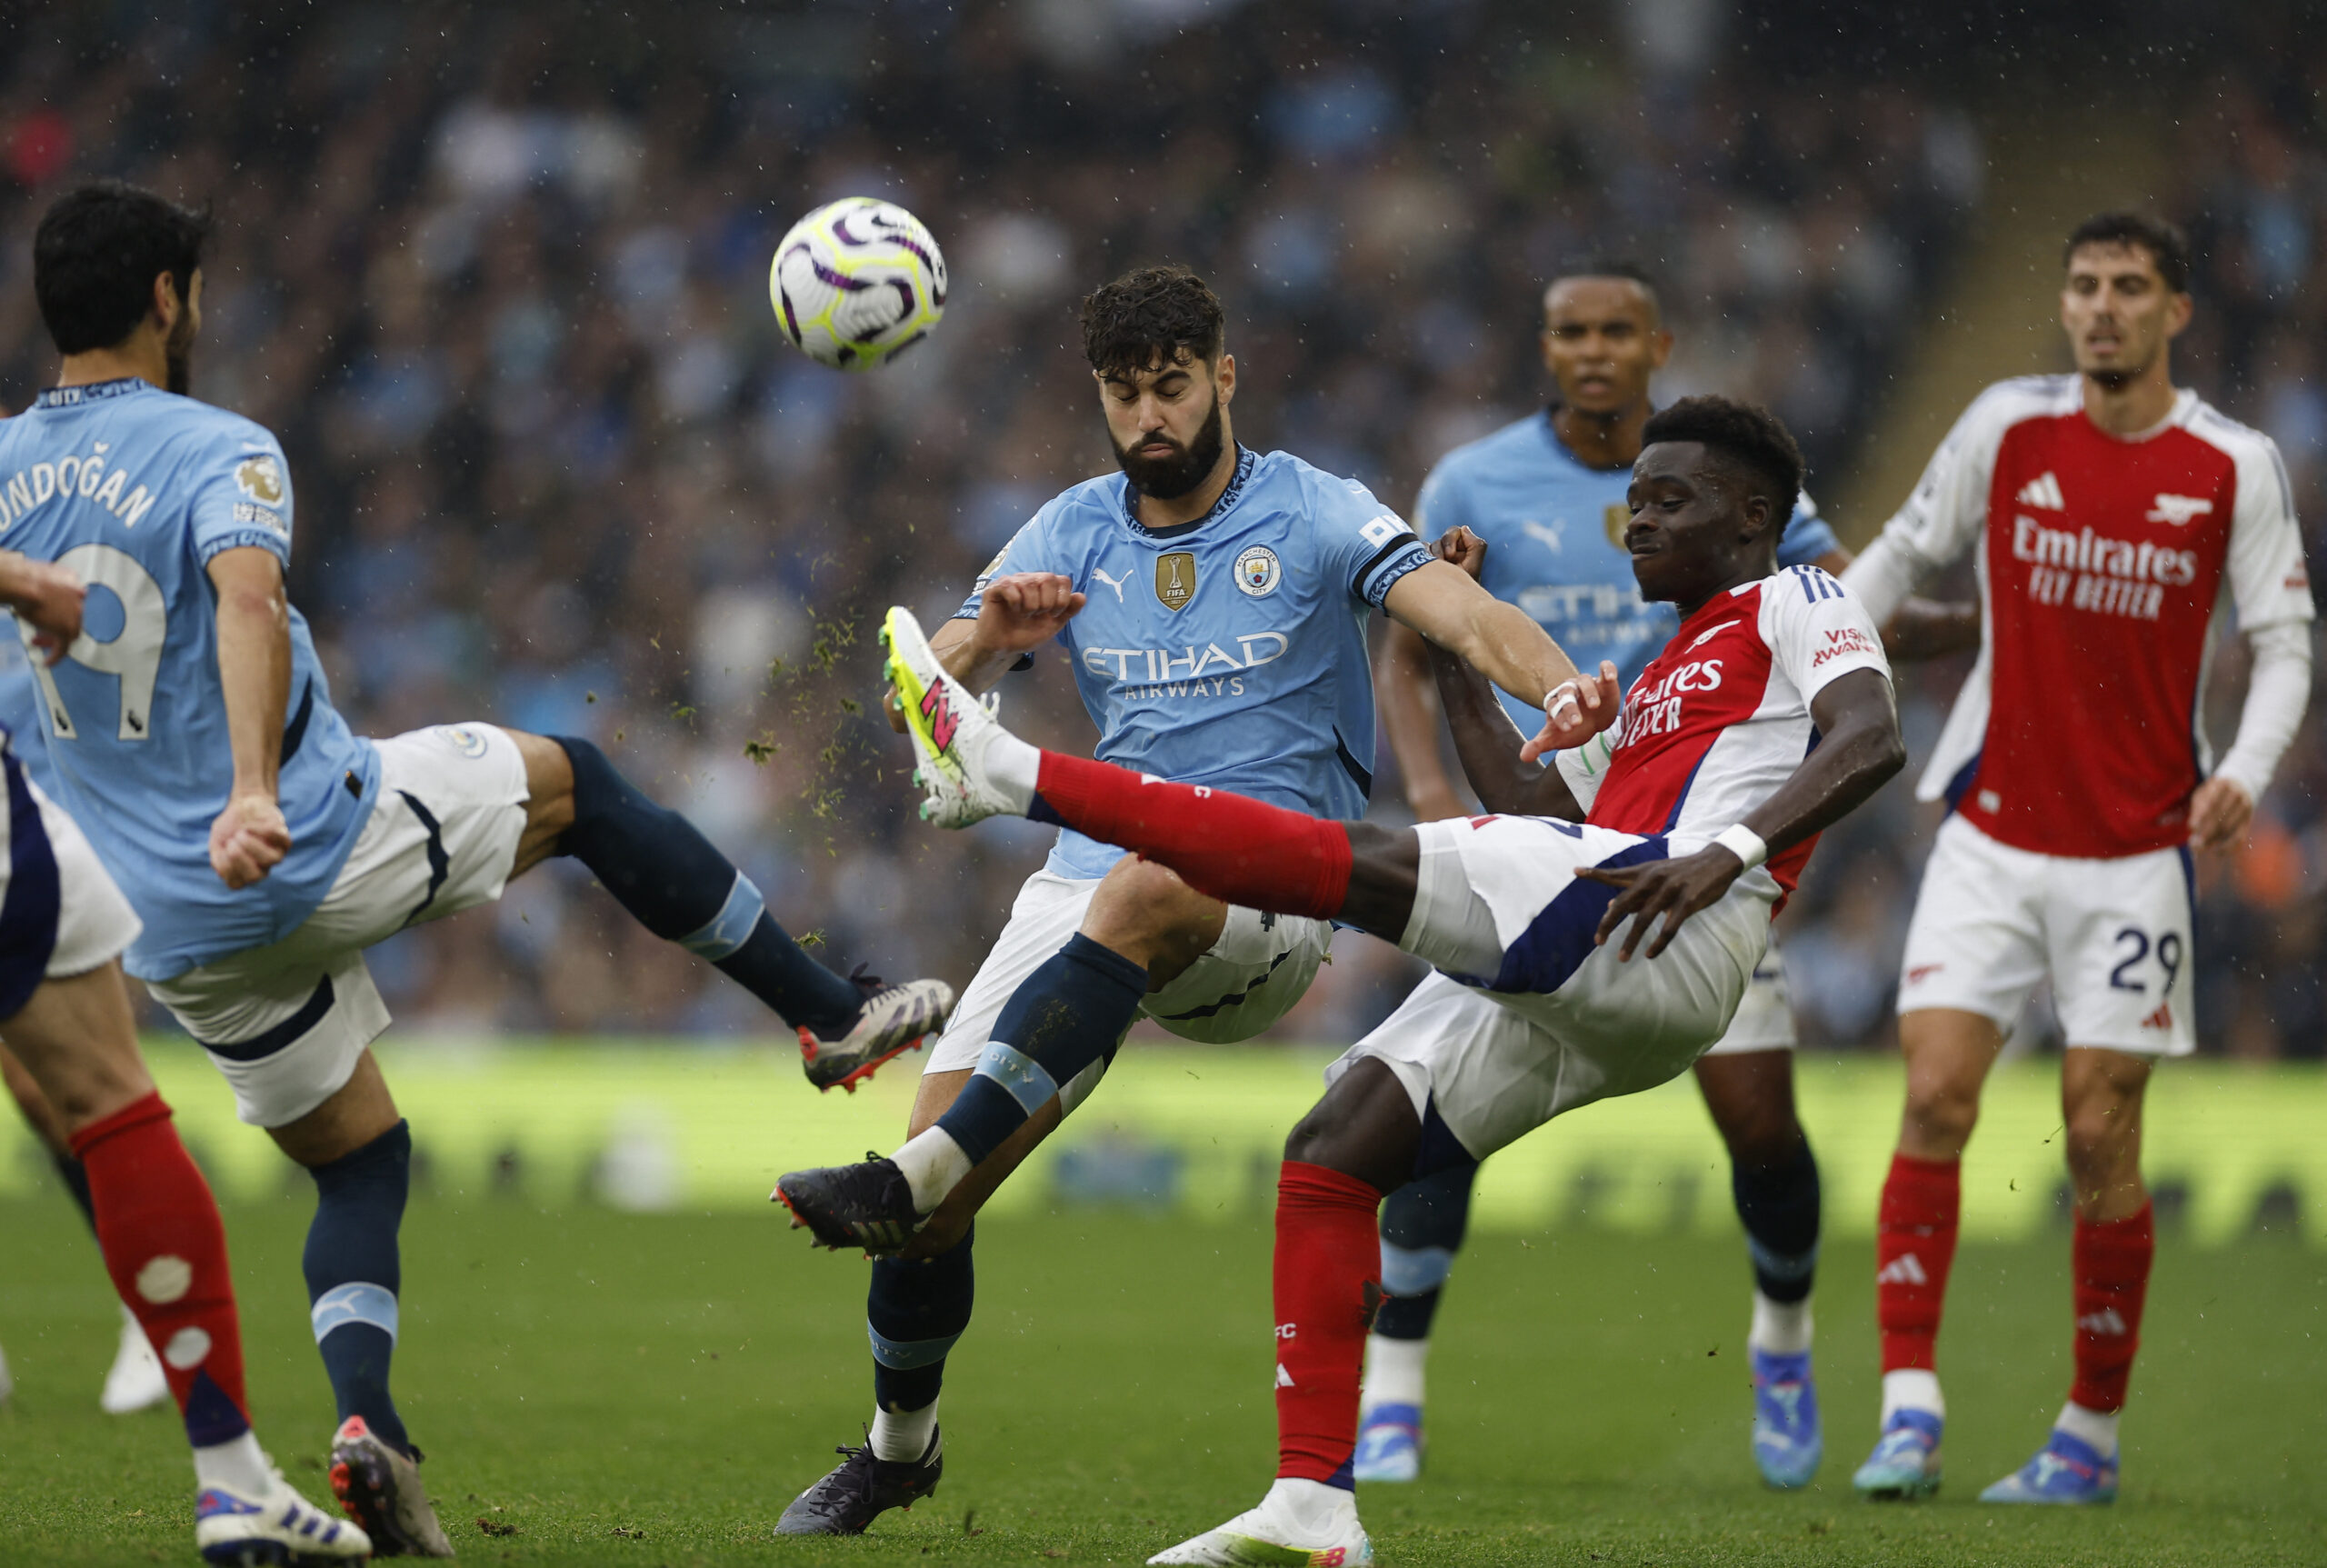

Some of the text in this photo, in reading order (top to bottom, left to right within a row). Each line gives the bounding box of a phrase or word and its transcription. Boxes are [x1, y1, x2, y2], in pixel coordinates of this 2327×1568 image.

[1237, 548, 1276, 567] MANCHESTER
[2012, 514, 2198, 586] Emirates
[1166, 588, 1185, 597] FIFA
[1082, 631, 1289, 681] ETIHAD
[1124, 676, 1245, 701] AIRWAYS
[2110, 928, 2182, 996] 29
